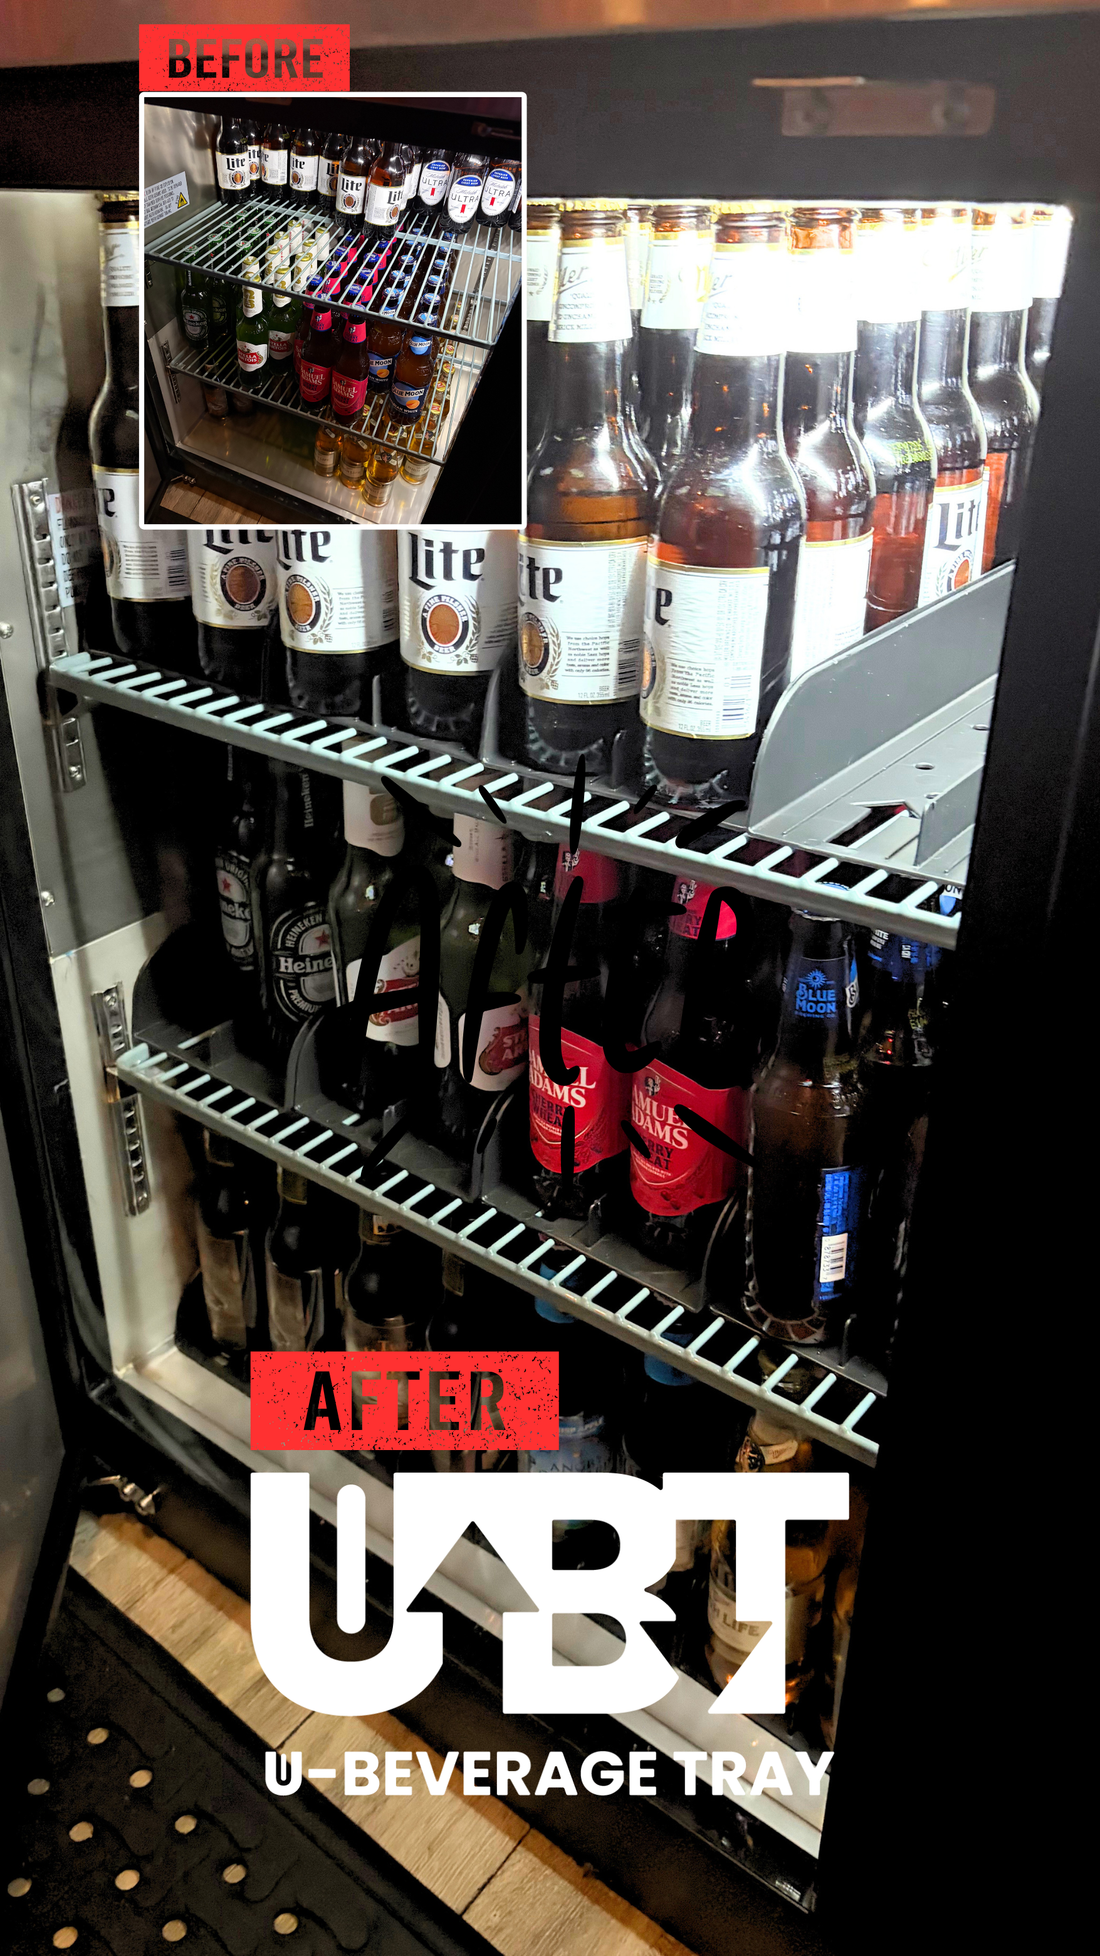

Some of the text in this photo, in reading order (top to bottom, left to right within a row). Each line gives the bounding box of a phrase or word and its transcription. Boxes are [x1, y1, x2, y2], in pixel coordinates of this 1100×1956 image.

[226, 157, 246, 171] Lite
[341, 177, 363, 193] Lite
[421, 177, 448, 187] ULTRA
[450, 192, 479, 203] ULTRA
[484, 186, 511, 198] ULTRA
[375, 358, 393, 366] MOON
[404, 389, 424, 397] MOON
[408, 532, 485, 591] Lite
[424, 595, 440, 610] FINE
[441, 595, 469, 622] PILSNER
[433, 644, 456, 652] BEER
[301, 773, 314, 828] Heineken
[285, 913, 324, 948] HEINEKEN
[278, 955, 333, 974] Heine
[796, 982, 837, 1002] BLUE
[795, 998, 837, 1014] MOON
[532, 1090, 566, 1116] CHERR
[532, 1105, 562, 1127] WHEA
[722, 1612, 761, 1638] LIFE
